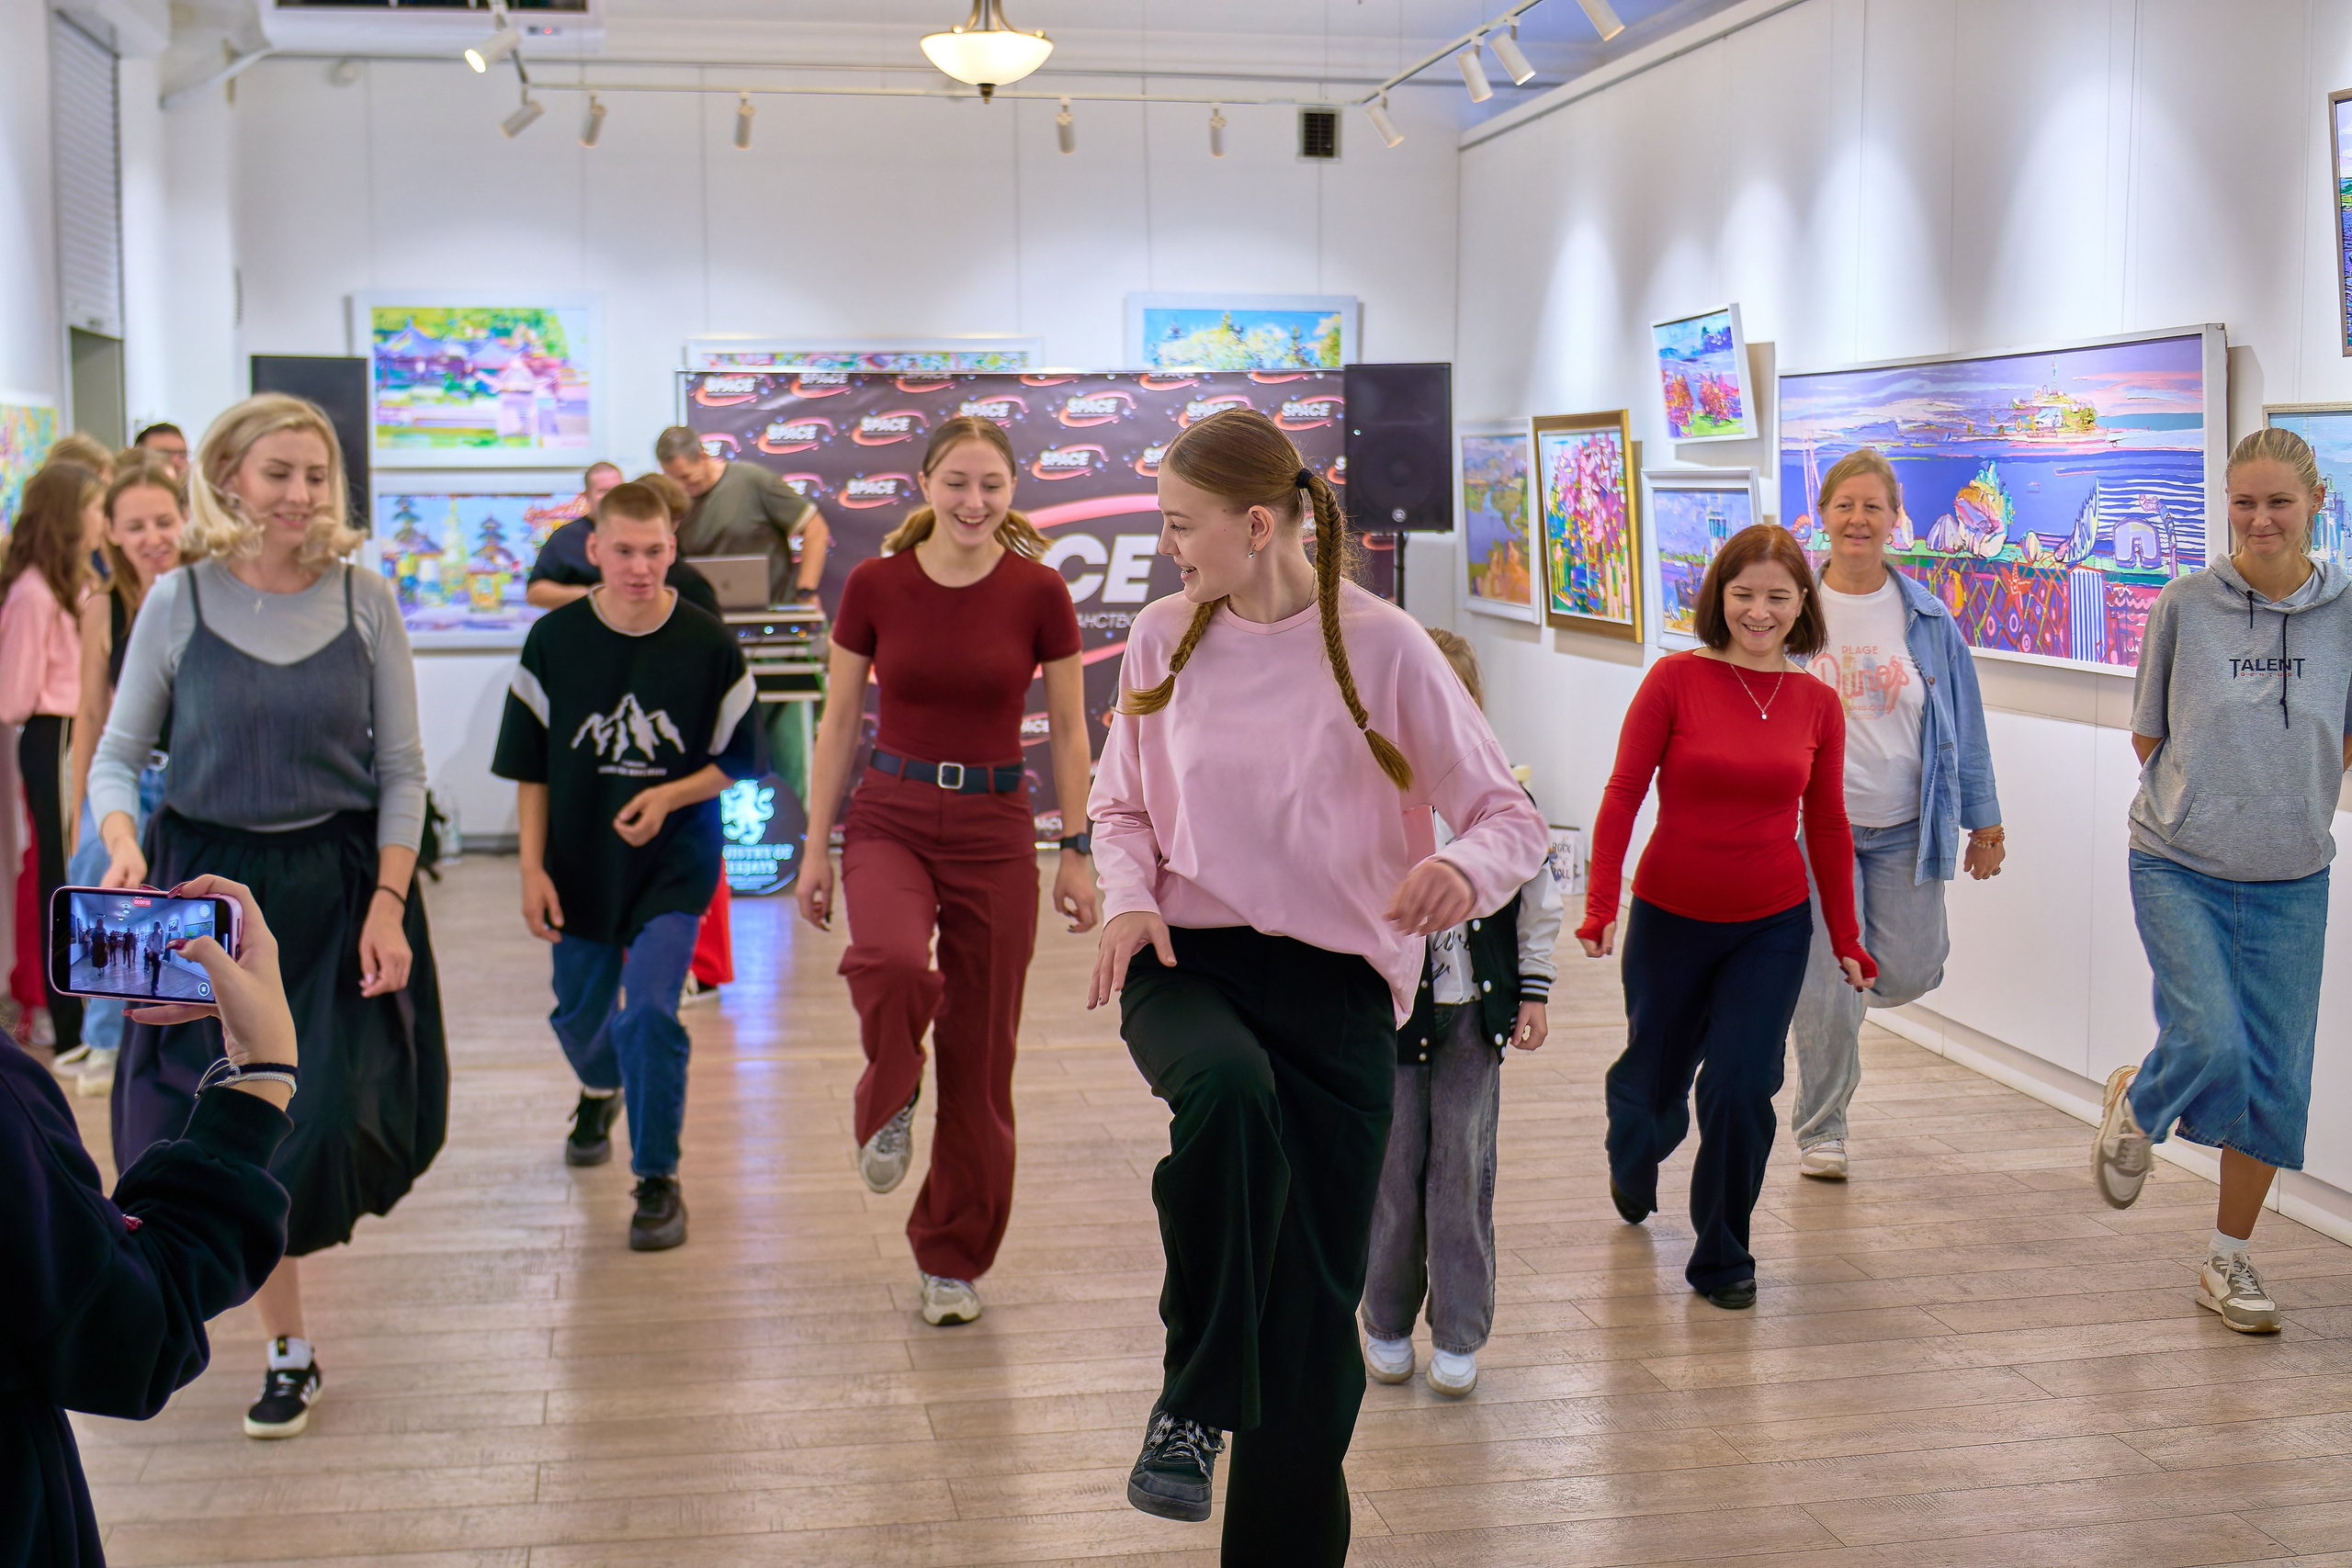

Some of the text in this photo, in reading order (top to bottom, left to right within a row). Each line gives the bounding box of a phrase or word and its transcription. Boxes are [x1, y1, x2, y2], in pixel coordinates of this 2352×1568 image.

[703, 375, 756, 393] SPACE
[958, 401, 1011, 418] SPACE
[1066, 397, 1118, 413] SPACE
[1281, 400, 1331, 417] SPACE
[765, 423, 818, 441] SPACE
[859, 416, 910, 433] SPACE
[1039, 450, 1091, 467] SPACE
[846, 478, 898, 495] SPACE
[1841, 645, 1879, 655] PLAGE
[2229, 659, 2306, 680] TALENT
